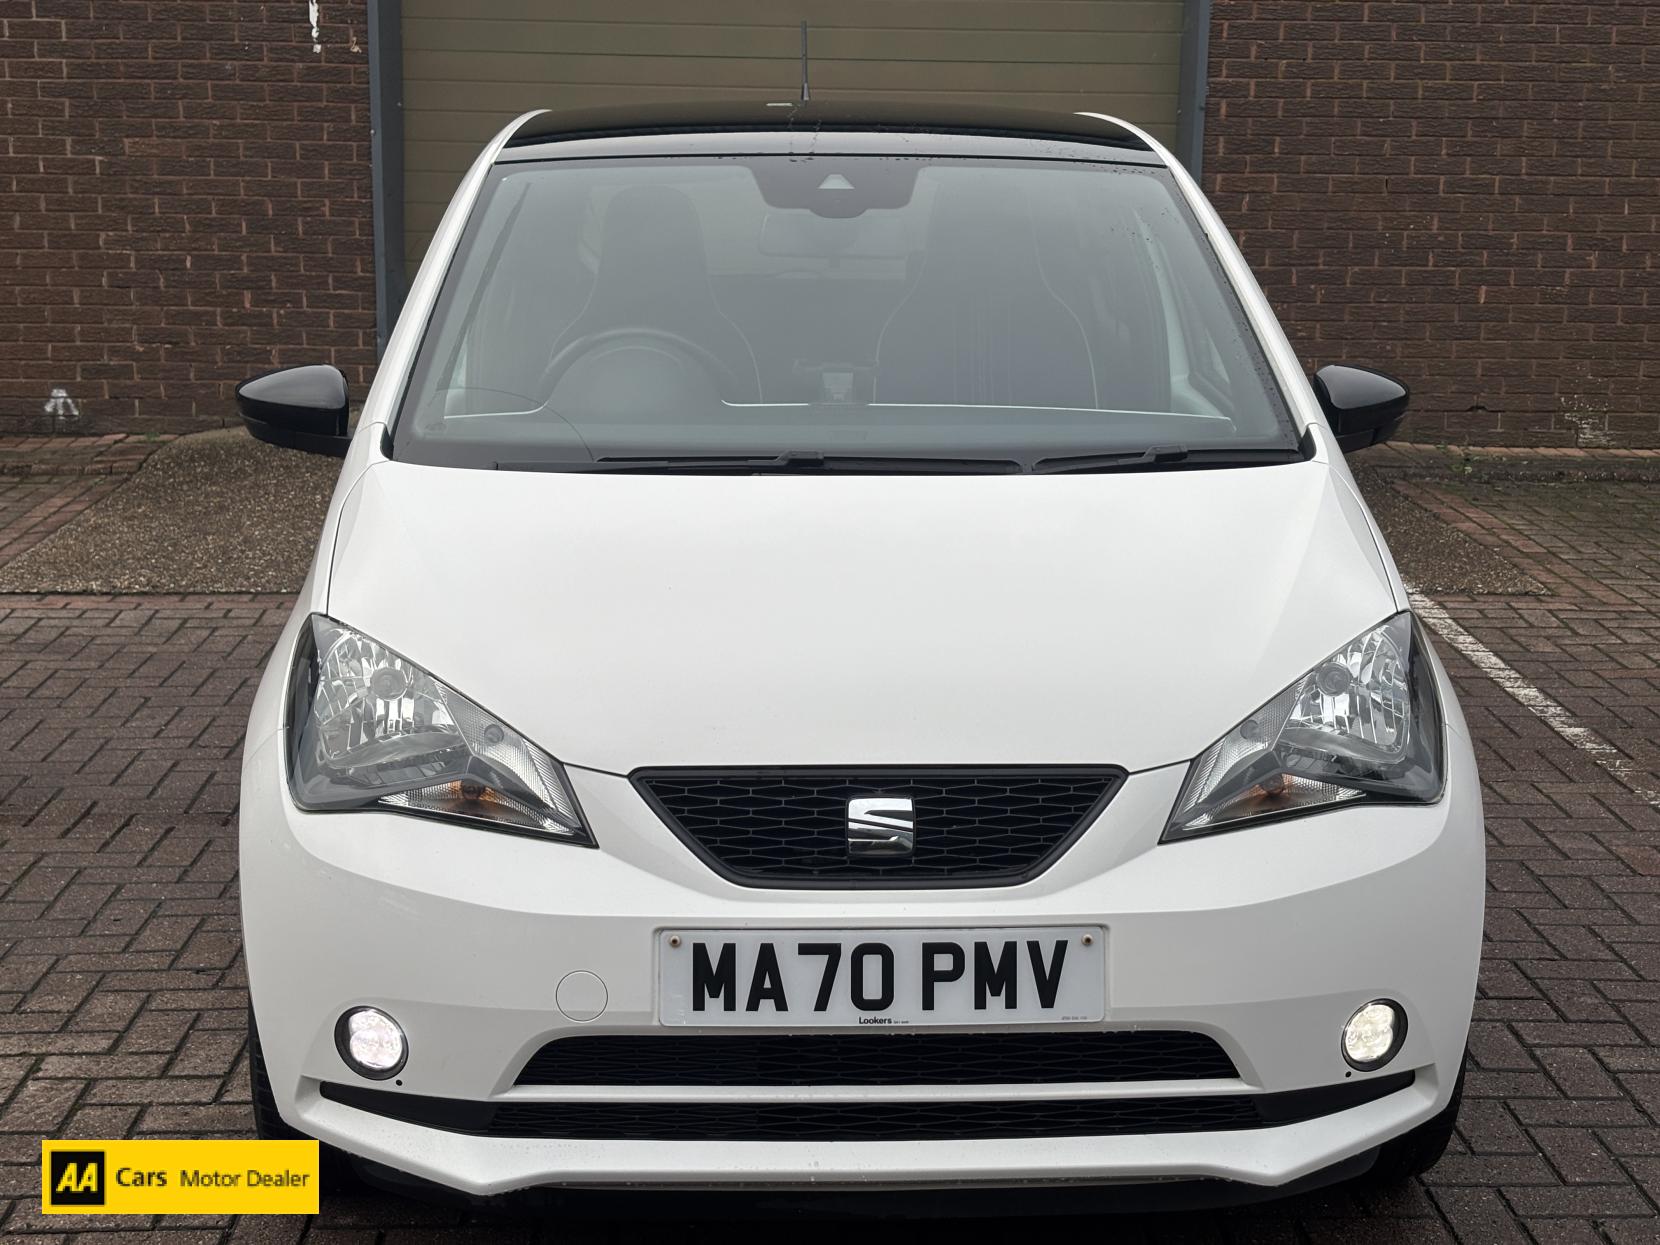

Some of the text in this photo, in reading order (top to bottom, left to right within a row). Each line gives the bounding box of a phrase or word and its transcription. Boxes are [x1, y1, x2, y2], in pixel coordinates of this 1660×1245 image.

[692, 940, 1068, 1011] MA70 PMV
[858, 1016, 892, 1025] Lookers
